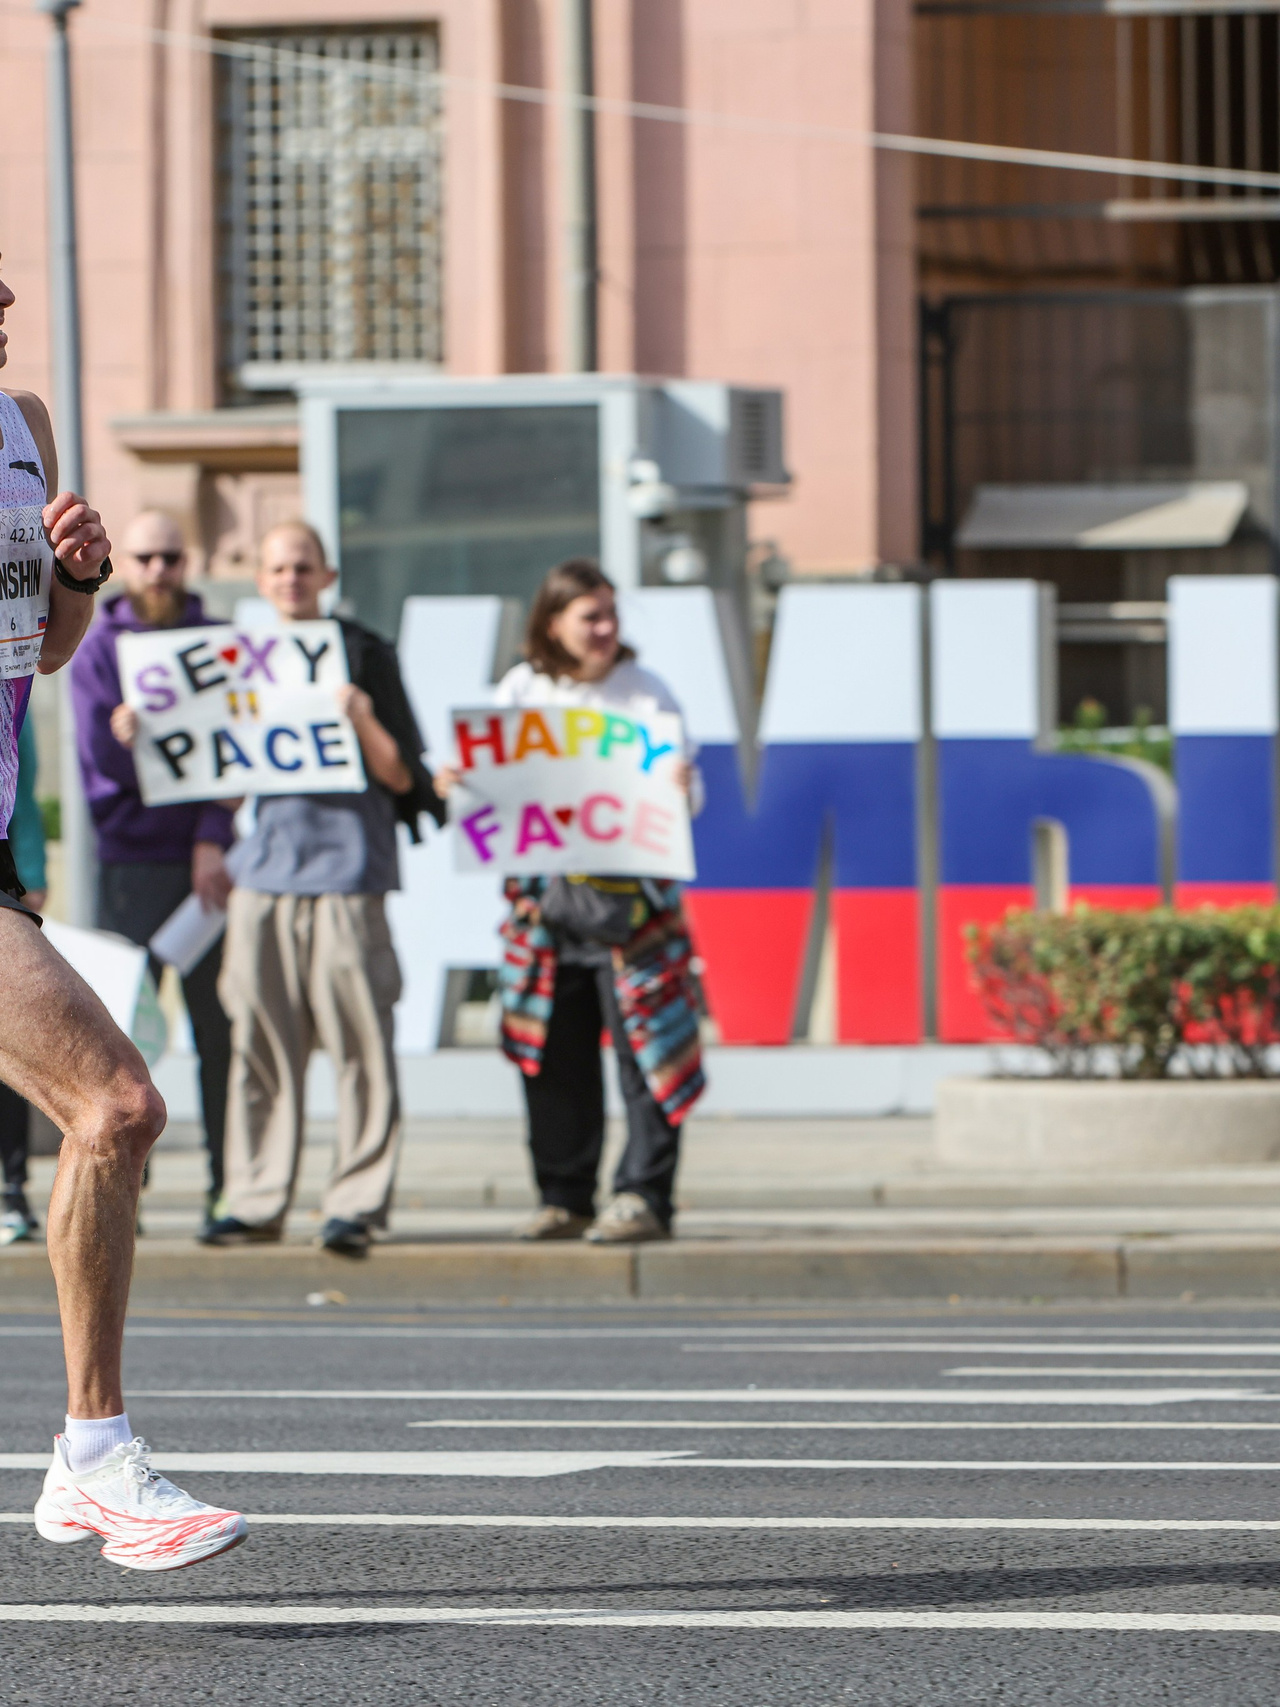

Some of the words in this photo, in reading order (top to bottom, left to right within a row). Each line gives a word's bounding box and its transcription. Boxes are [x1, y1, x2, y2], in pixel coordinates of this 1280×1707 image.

[10, 526, 35, 544] 42,2
[37, 526, 44, 541] K
[10, 617, 16, 631] 6
[135, 634, 329, 712] SEXY
[153, 722, 348, 780] PACE
[456, 709, 673, 772] HAPPY
[461, 793, 674, 863] FACE
